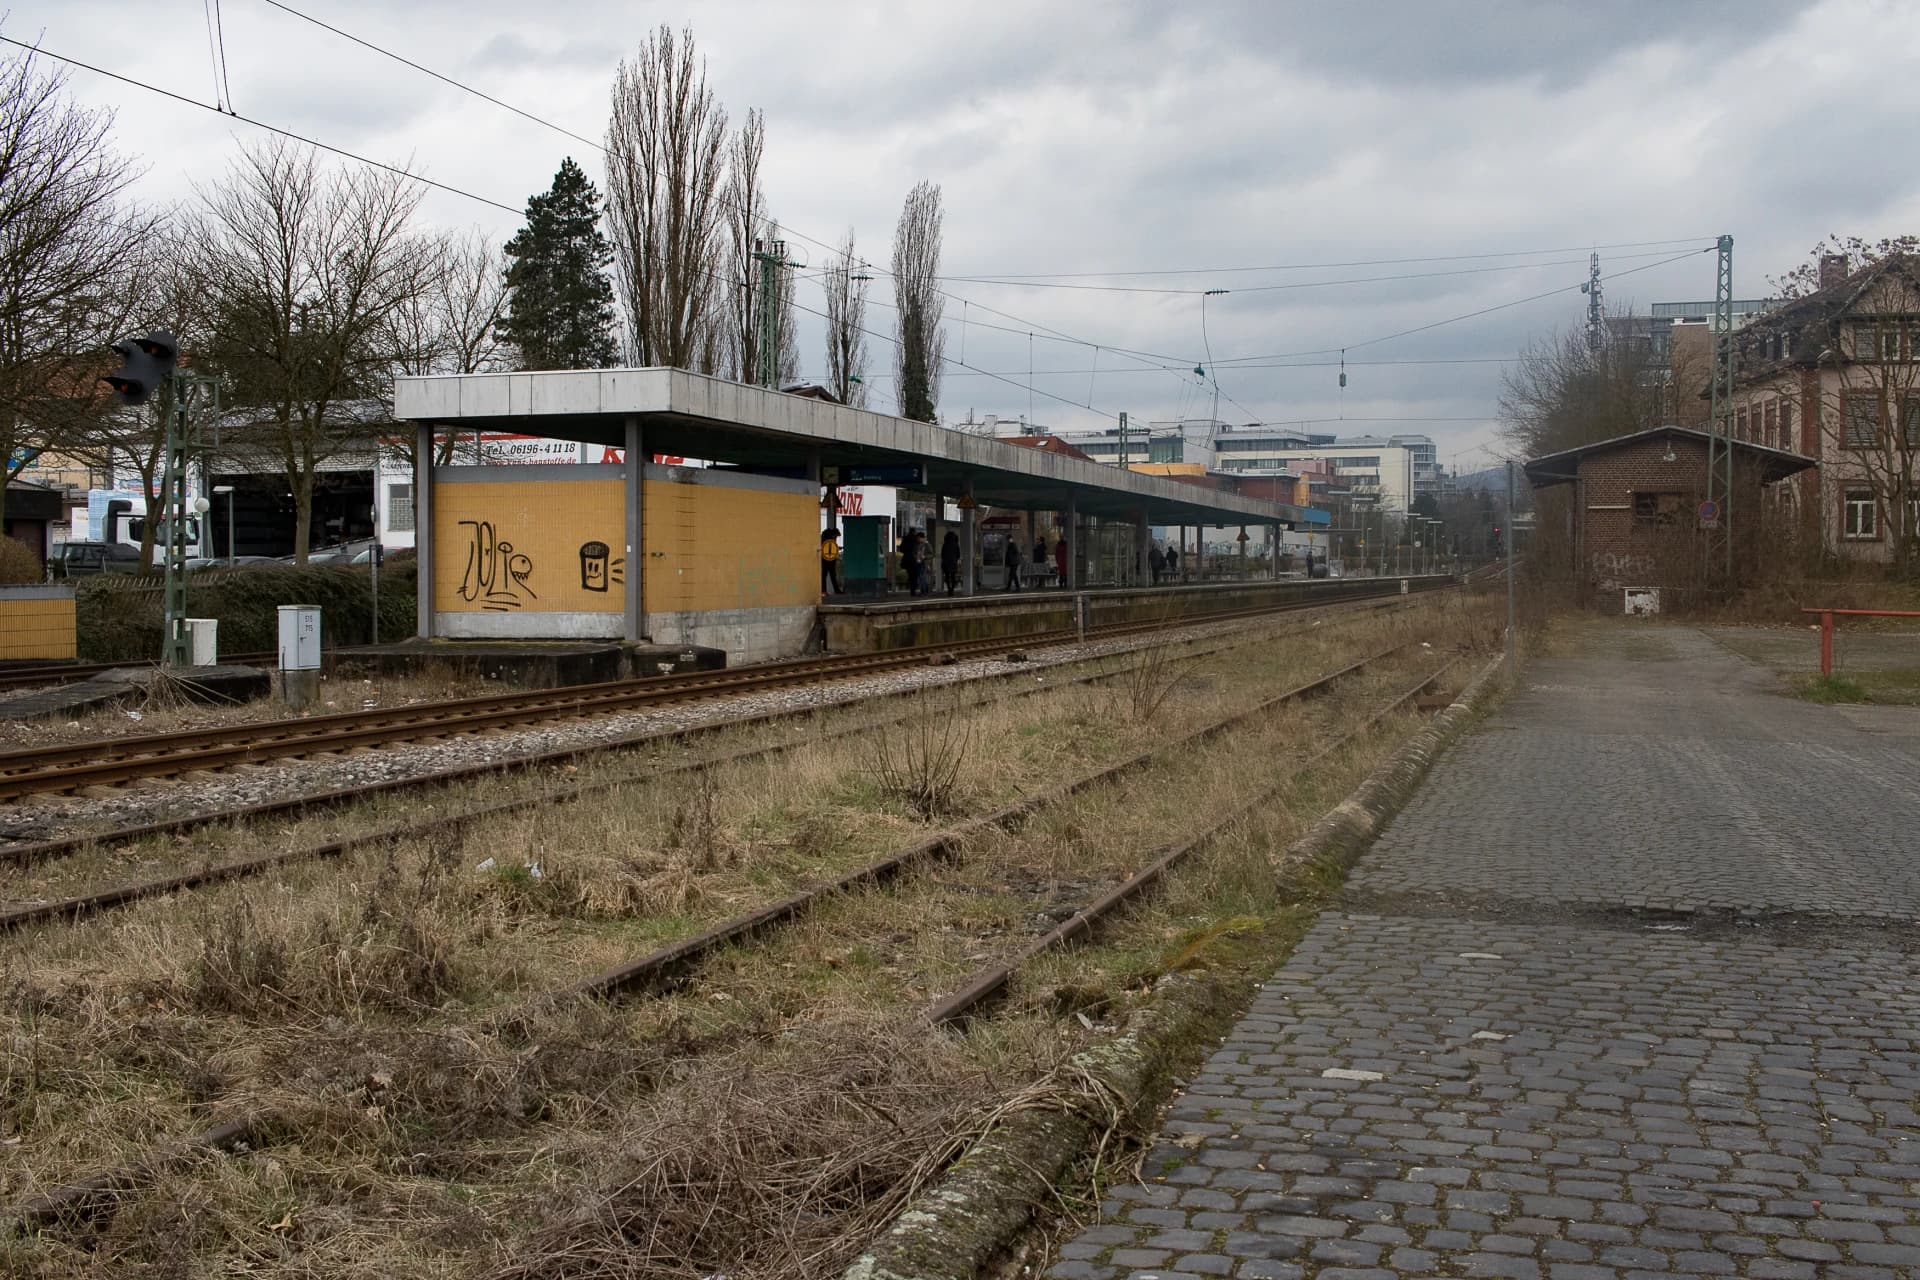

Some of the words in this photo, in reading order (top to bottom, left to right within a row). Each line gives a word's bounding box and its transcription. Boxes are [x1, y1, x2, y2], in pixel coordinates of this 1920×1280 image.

[486, 445, 505, 455] Tel.
[553, 443, 562, 454] 11
[564, 442, 576, 453] 18
